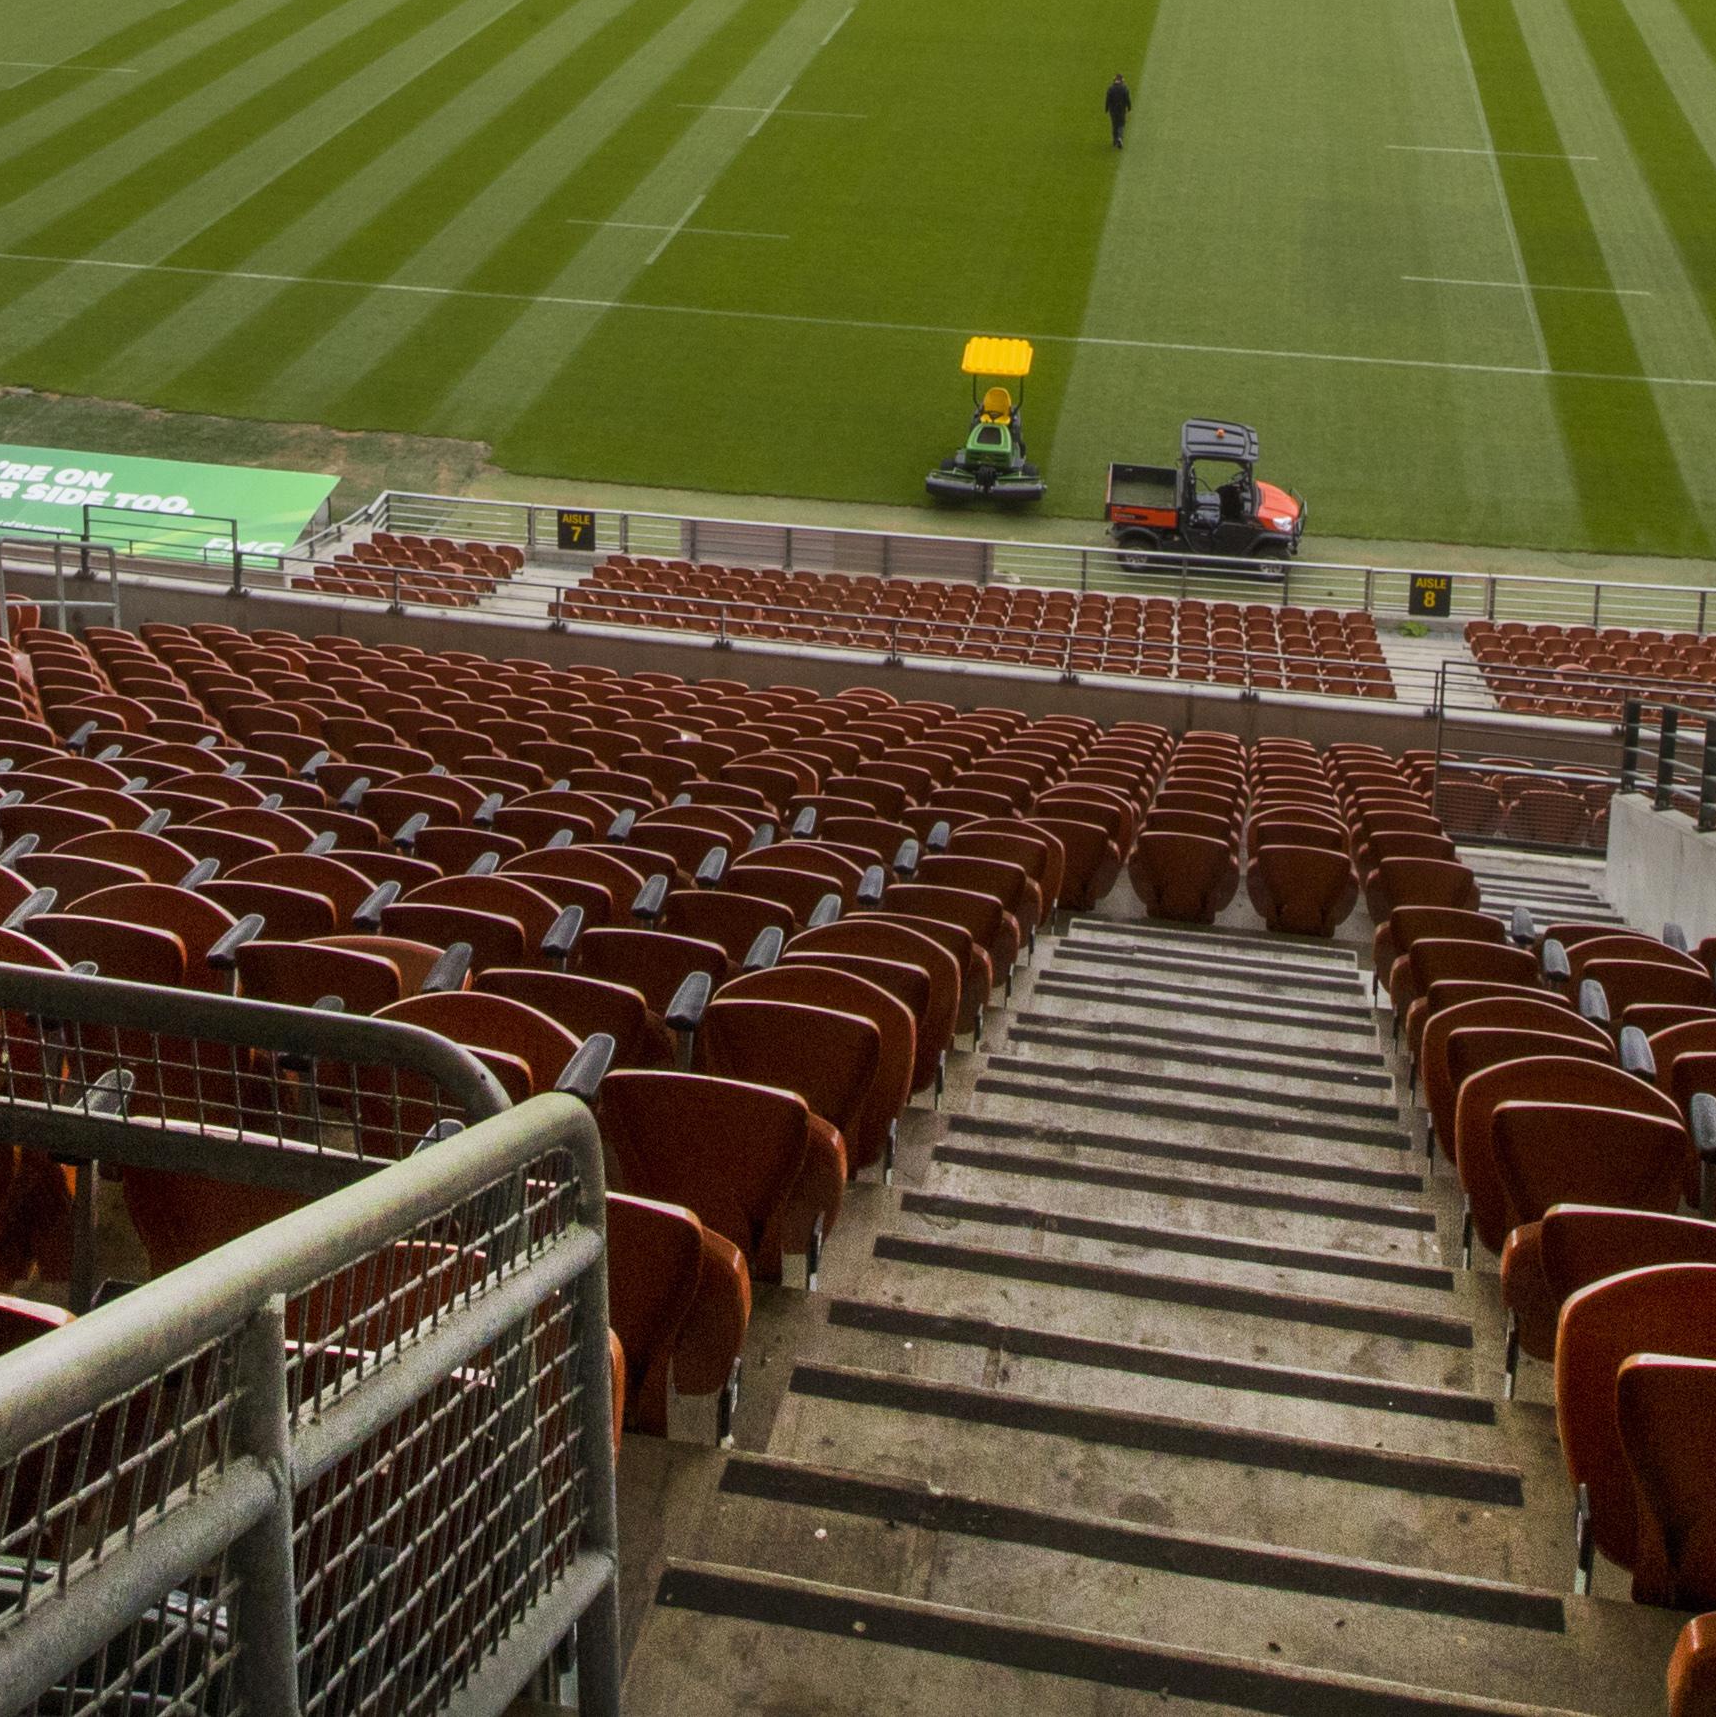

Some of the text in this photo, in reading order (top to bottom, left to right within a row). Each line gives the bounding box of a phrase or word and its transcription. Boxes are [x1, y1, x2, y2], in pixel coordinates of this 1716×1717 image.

[54, 468, 113, 489] ON
[21, 483, 111, 506] SIDE
[112, 492, 196, 515] TOO.
[563, 513, 591, 525] AISLE
[571, 526, 582, 542] 7
[1415, 577, 1447, 590] AISLE
[1423, 590, 1436, 608] 8
